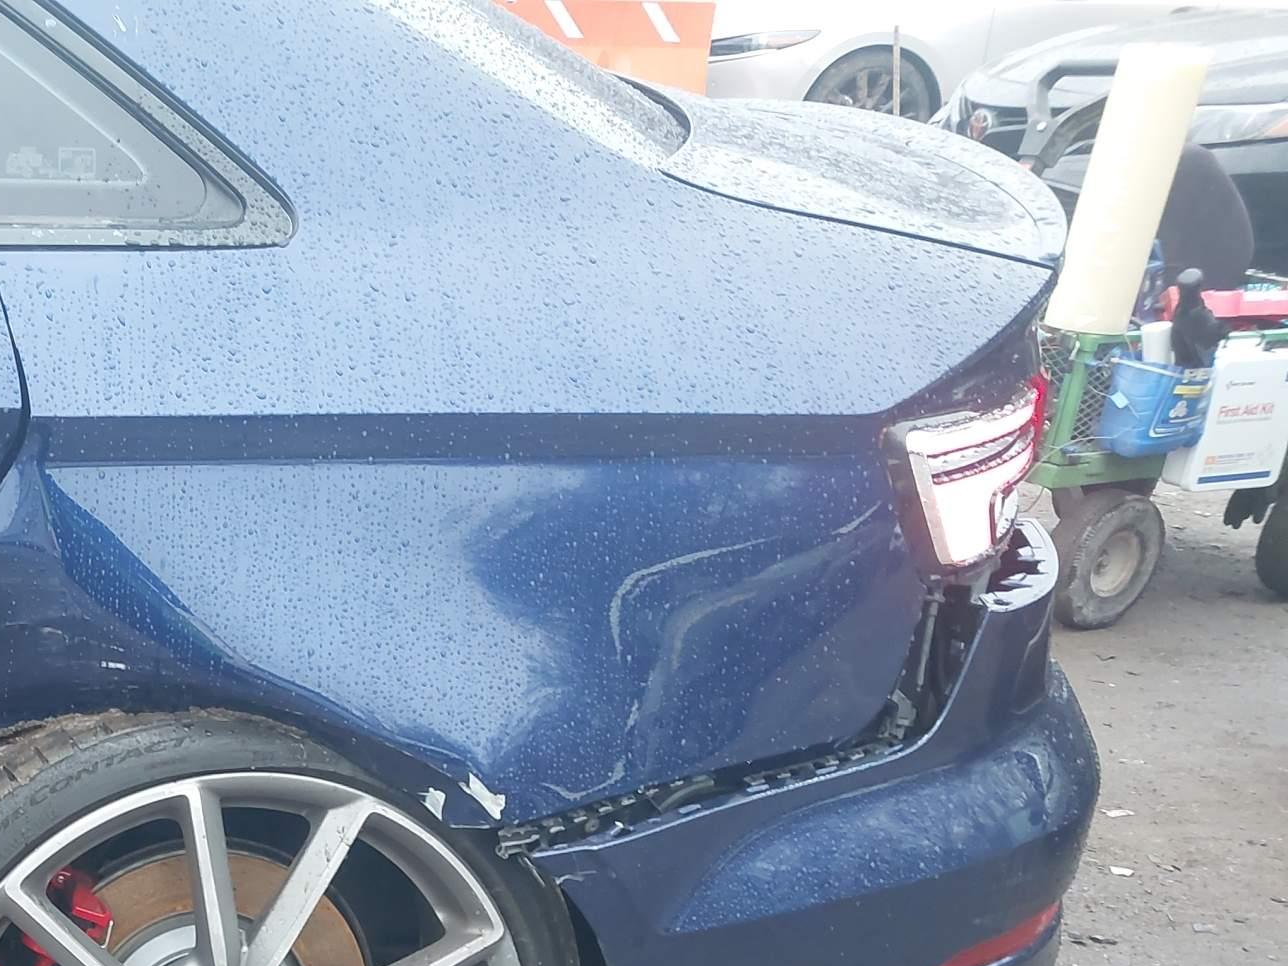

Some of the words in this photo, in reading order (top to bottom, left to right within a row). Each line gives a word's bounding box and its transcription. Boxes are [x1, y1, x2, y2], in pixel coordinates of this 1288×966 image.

[1218, 405, 1241, 417] First
[1242, 403, 1261, 417] Aid
[1262, 402, 1275, 416] Kit
